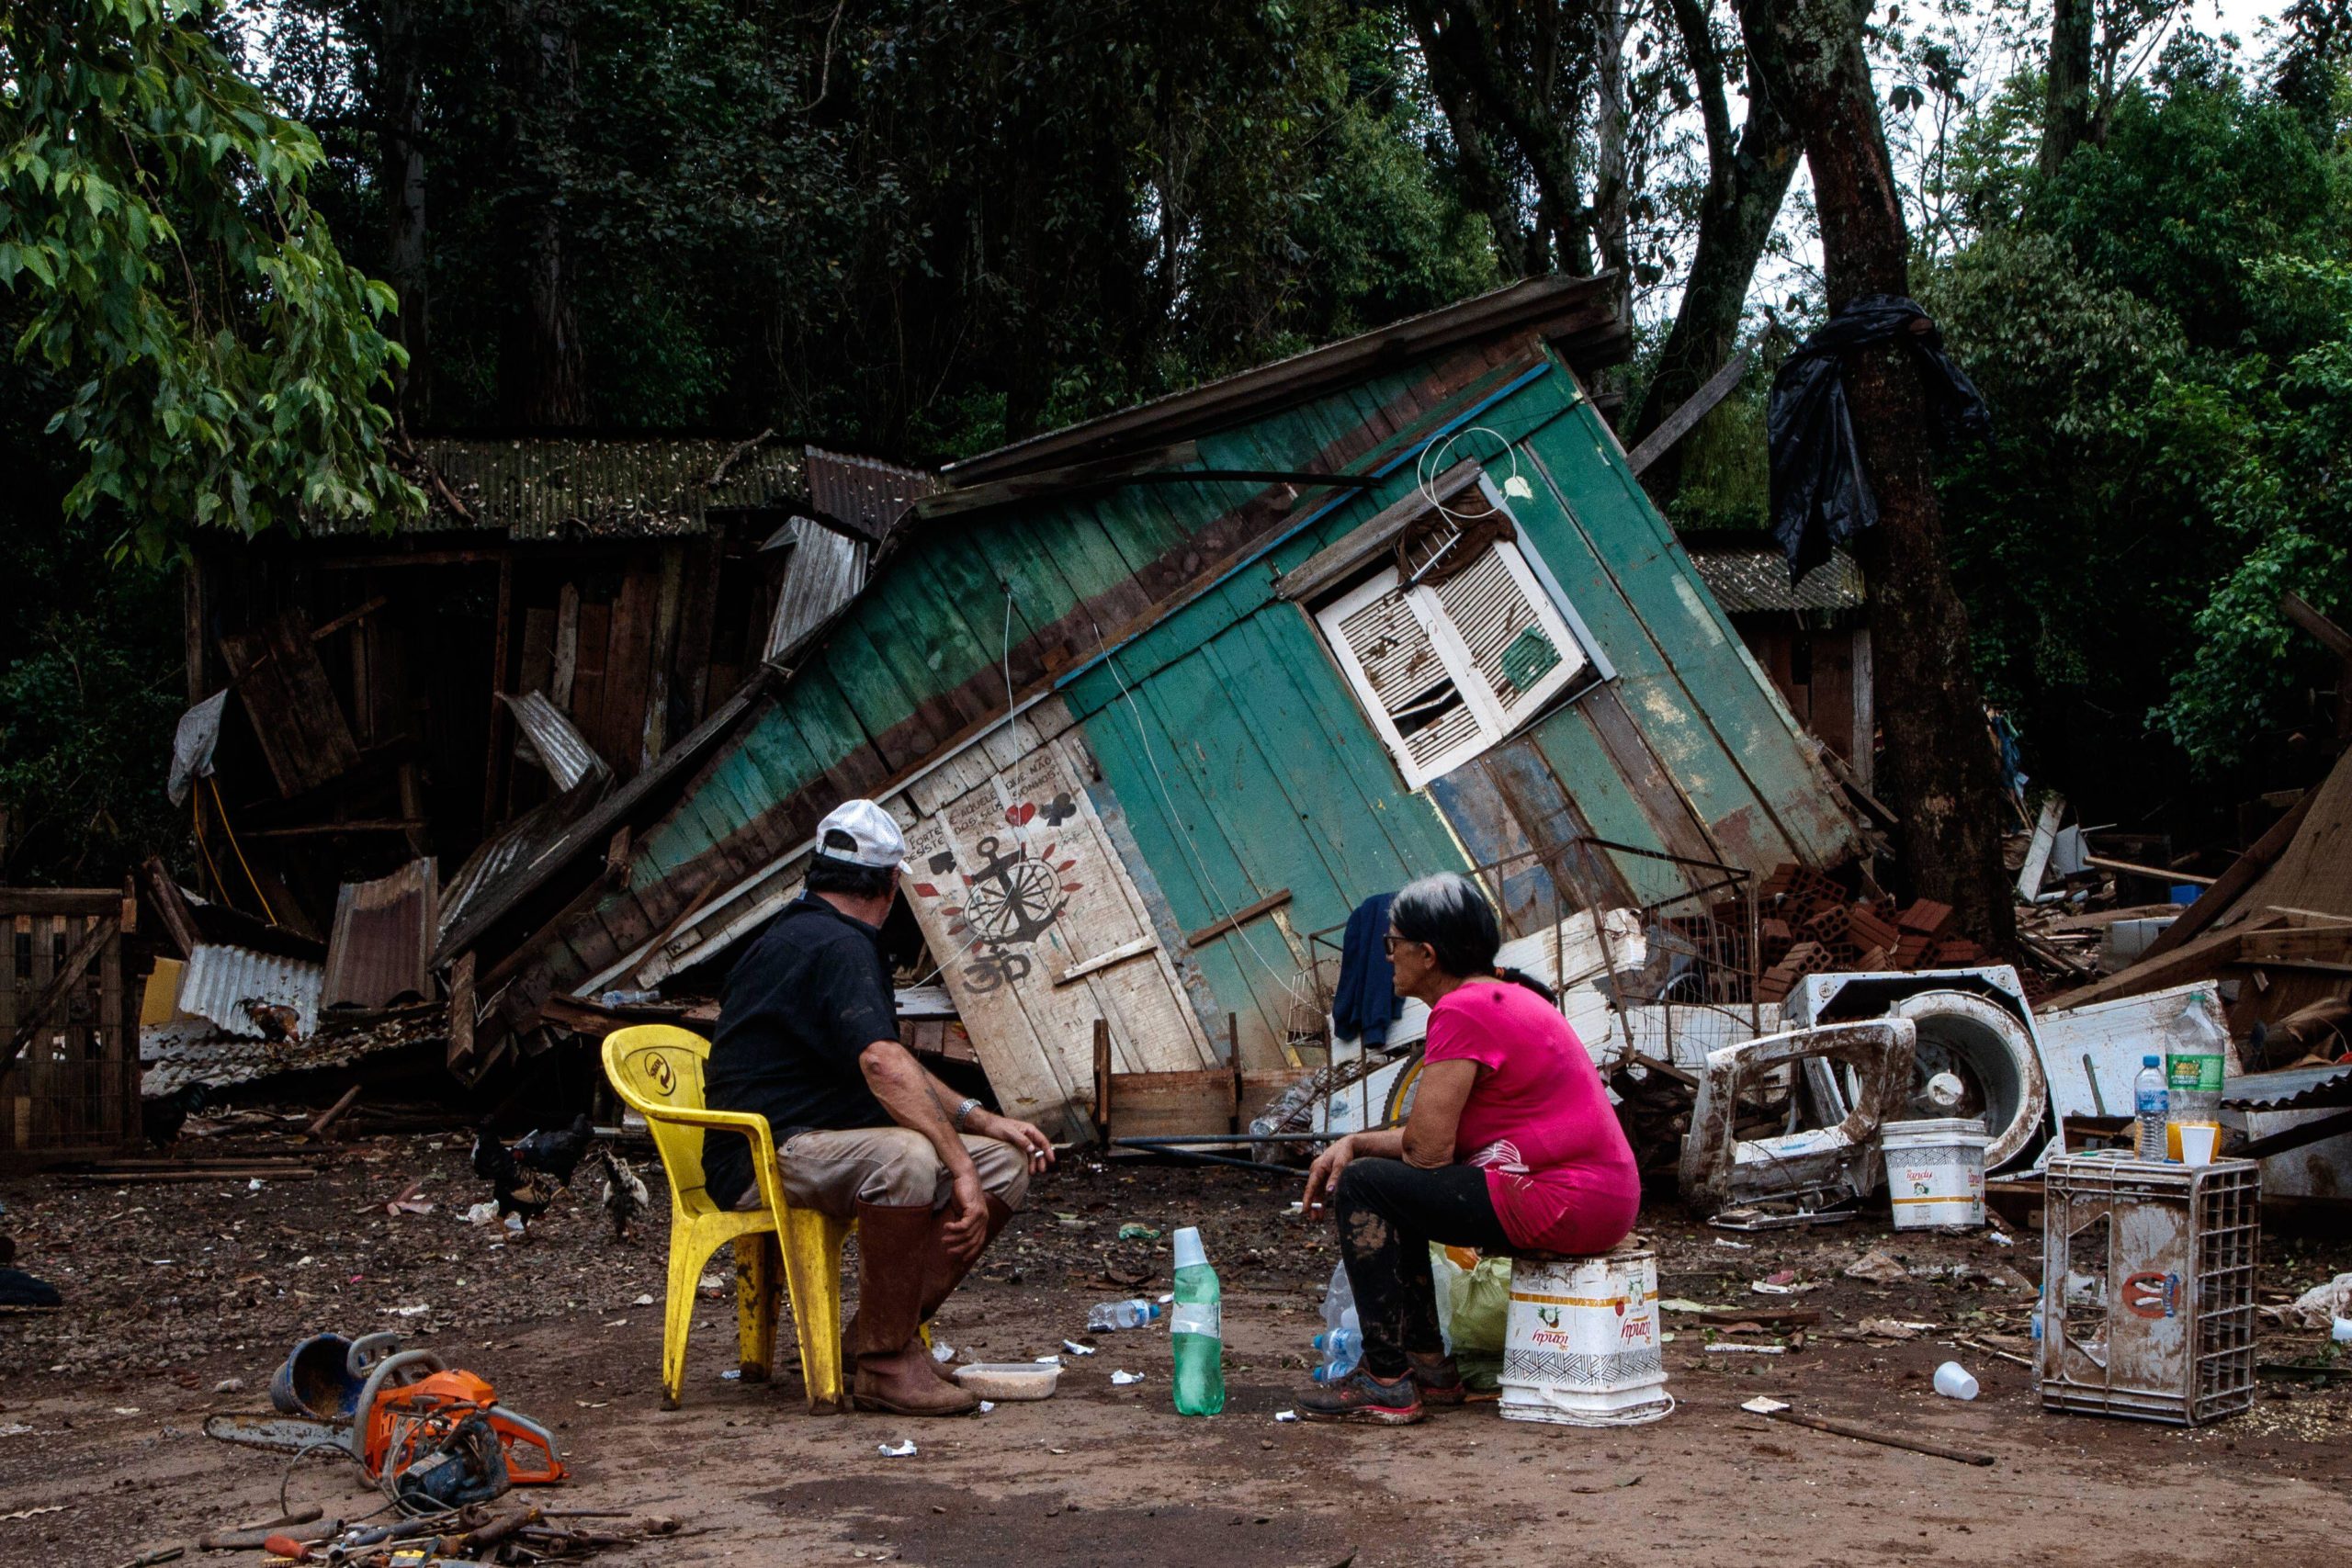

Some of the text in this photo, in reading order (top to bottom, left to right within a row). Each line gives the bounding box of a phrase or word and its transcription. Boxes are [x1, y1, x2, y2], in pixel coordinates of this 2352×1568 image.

[903, 836, 945, 864] DESISTE
[955, 818, 977, 836] DOS
[980, 800, 1004, 819] SEUS
[909, 827, 943, 850] FORTE
[961, 792, 998, 818] AQUELE
[1006, 772, 1027, 790] QUE
[1029, 756, 1052, 774] NÃO
